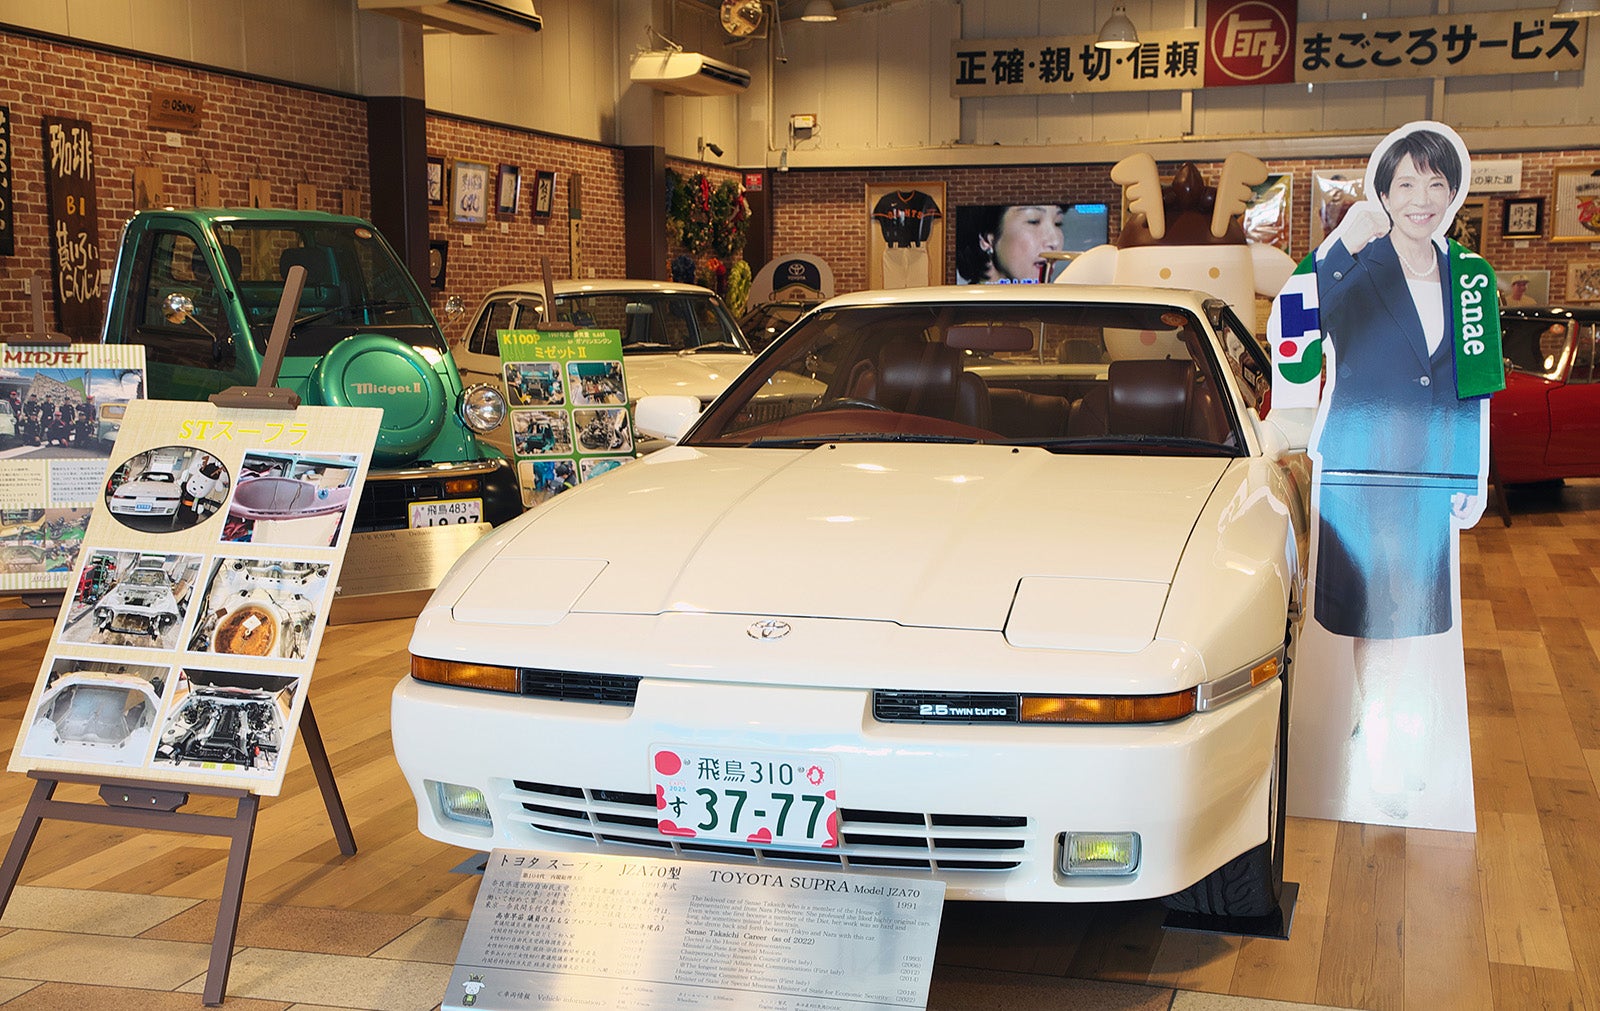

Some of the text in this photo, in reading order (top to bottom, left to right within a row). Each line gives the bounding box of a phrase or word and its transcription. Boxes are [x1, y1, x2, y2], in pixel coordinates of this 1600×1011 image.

[1302, 20, 1580, 70] まごころサービス
[49, 123, 93, 181] 珈琲
[1459, 273, 1489, 356] Sanae
[4, 350, 88, 366] MIDJET
[535, 346, 576, 359] ミゼット
[351, 383, 411, 395] Midget
[919, 704, 1007, 716] 2.5 TWIN turbo
[669, 787, 826, 839] す 37-77
[500, 854, 540, 868] トヨタ
[618, 863, 682, 881] JZA70型
[710, 870, 921, 898] TOYOTA SUPRA Model JZA70
[896, 901, 918, 910] 1991
[685, 928, 707, 936] Sanae
[708, 930, 739, 938] Takaichi
[743, 933, 767, 941] Career
